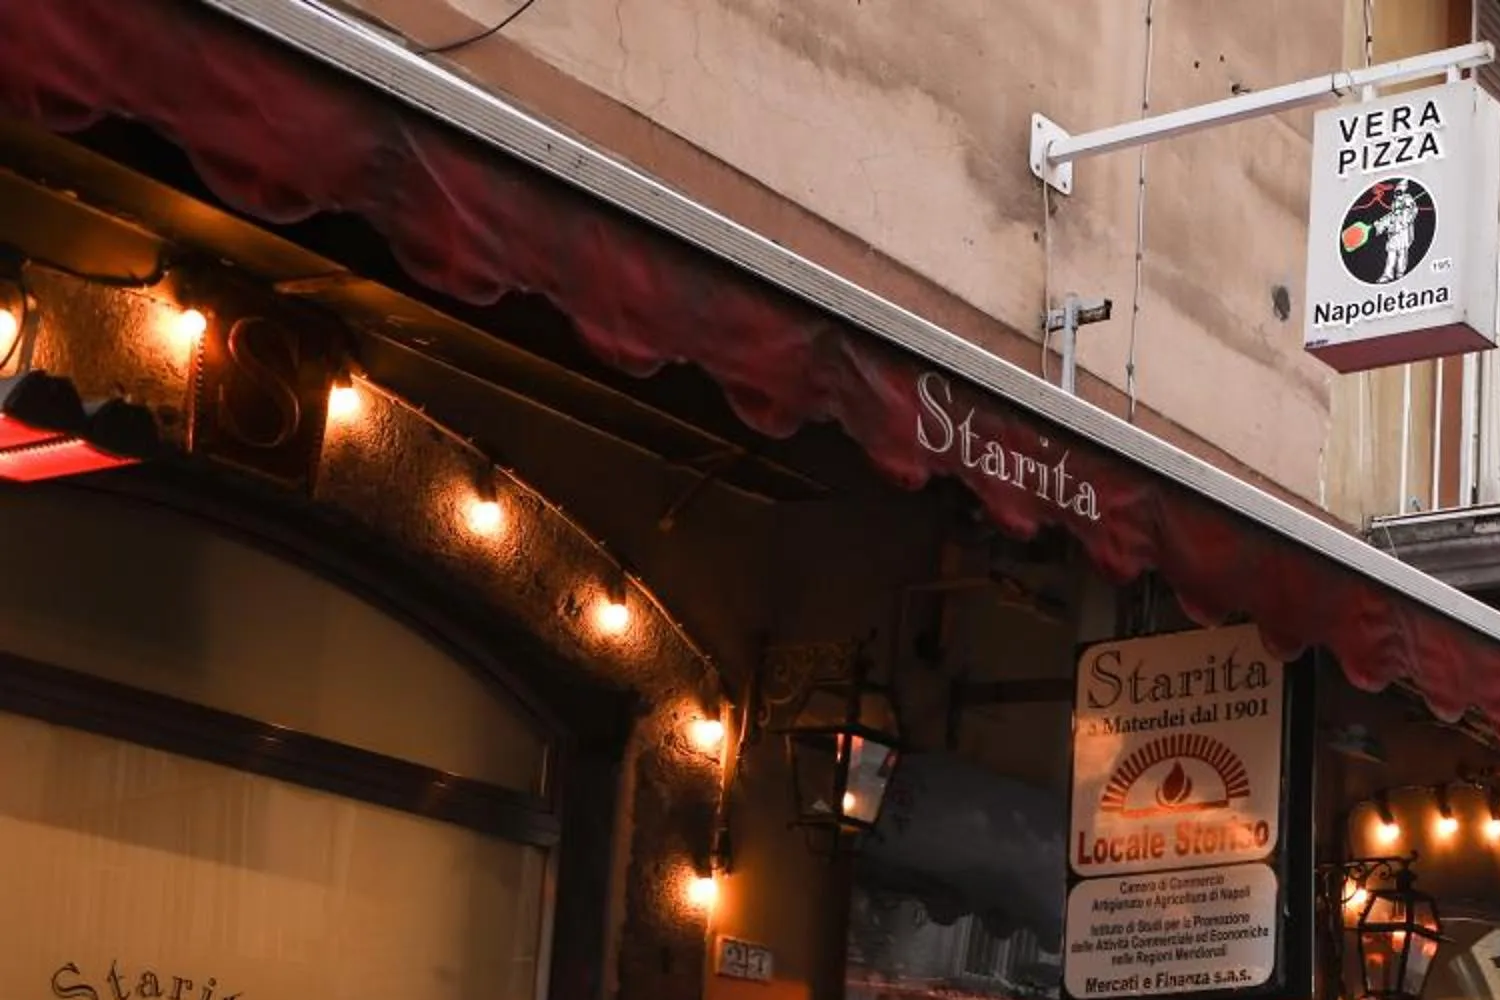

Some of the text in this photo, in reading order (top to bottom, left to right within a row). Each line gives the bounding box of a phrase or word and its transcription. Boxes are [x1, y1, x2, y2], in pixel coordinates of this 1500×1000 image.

[1339, 100, 1441, 143] VERA
[1338, 133, 1439, 174] PIZZA
[1314, 286, 1449, 325] Napoletana
[917, 371, 1101, 521] Starita
[1087, 644, 1271, 709] Starita
[1103, 709, 1185, 735] Materdei
[1190, 704, 1218, 724] dal
[1226, 699, 1269, 720] 1901
[1078, 827, 1166, 865] Locale
[1219, 886, 1250, 902] Napoli
[1210, 925, 1269, 941] Economiche
[1085, 969, 1252, 994] Mercati e Finanza s.a.s.
